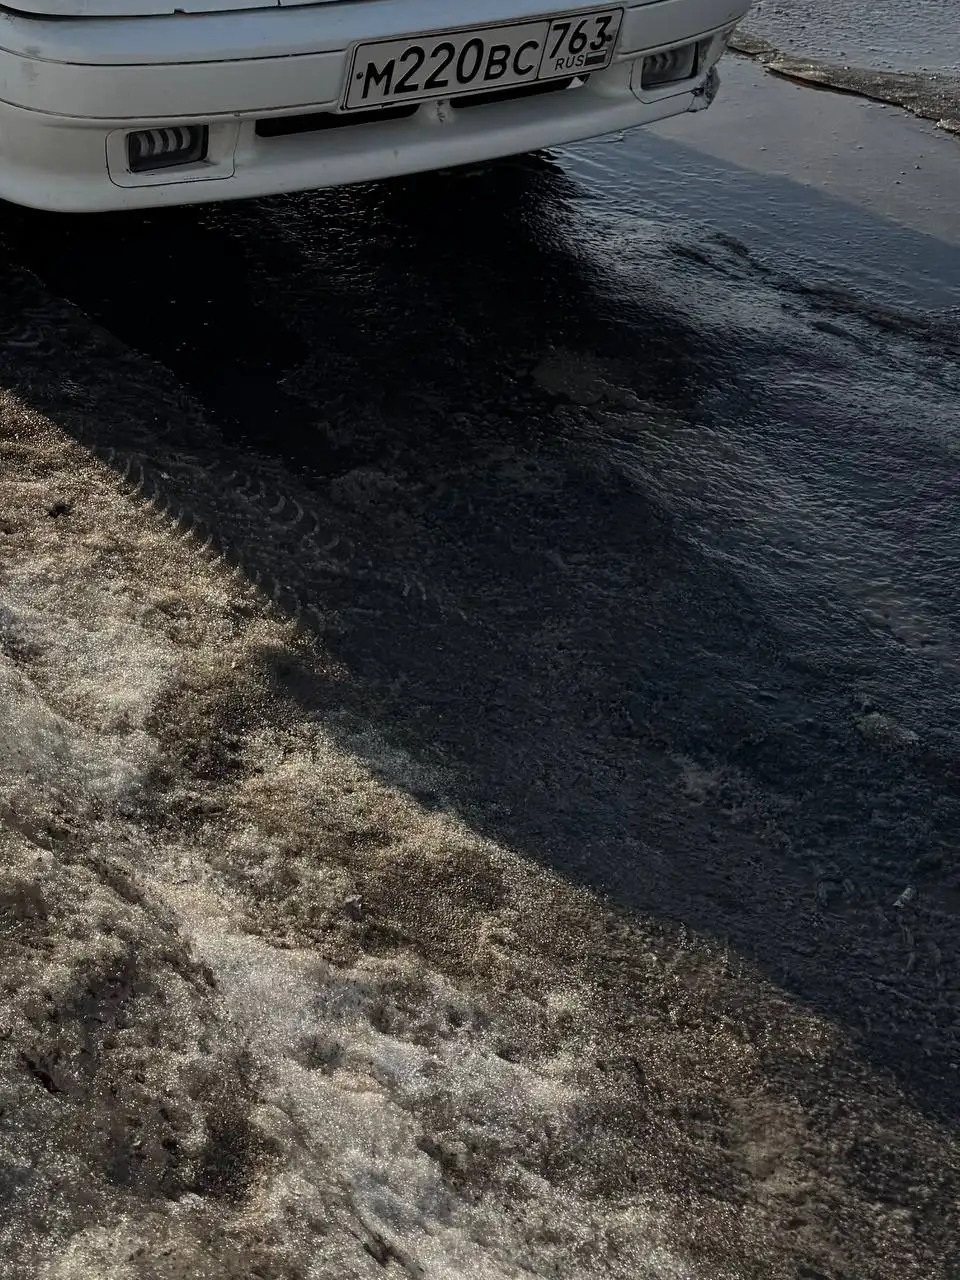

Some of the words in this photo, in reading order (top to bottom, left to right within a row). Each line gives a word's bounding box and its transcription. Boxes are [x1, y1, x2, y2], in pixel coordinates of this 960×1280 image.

[361, 37, 540, 99] М220ВС
[549, 15, 613, 59] 763
[554, 53, 585, 71] RUS
